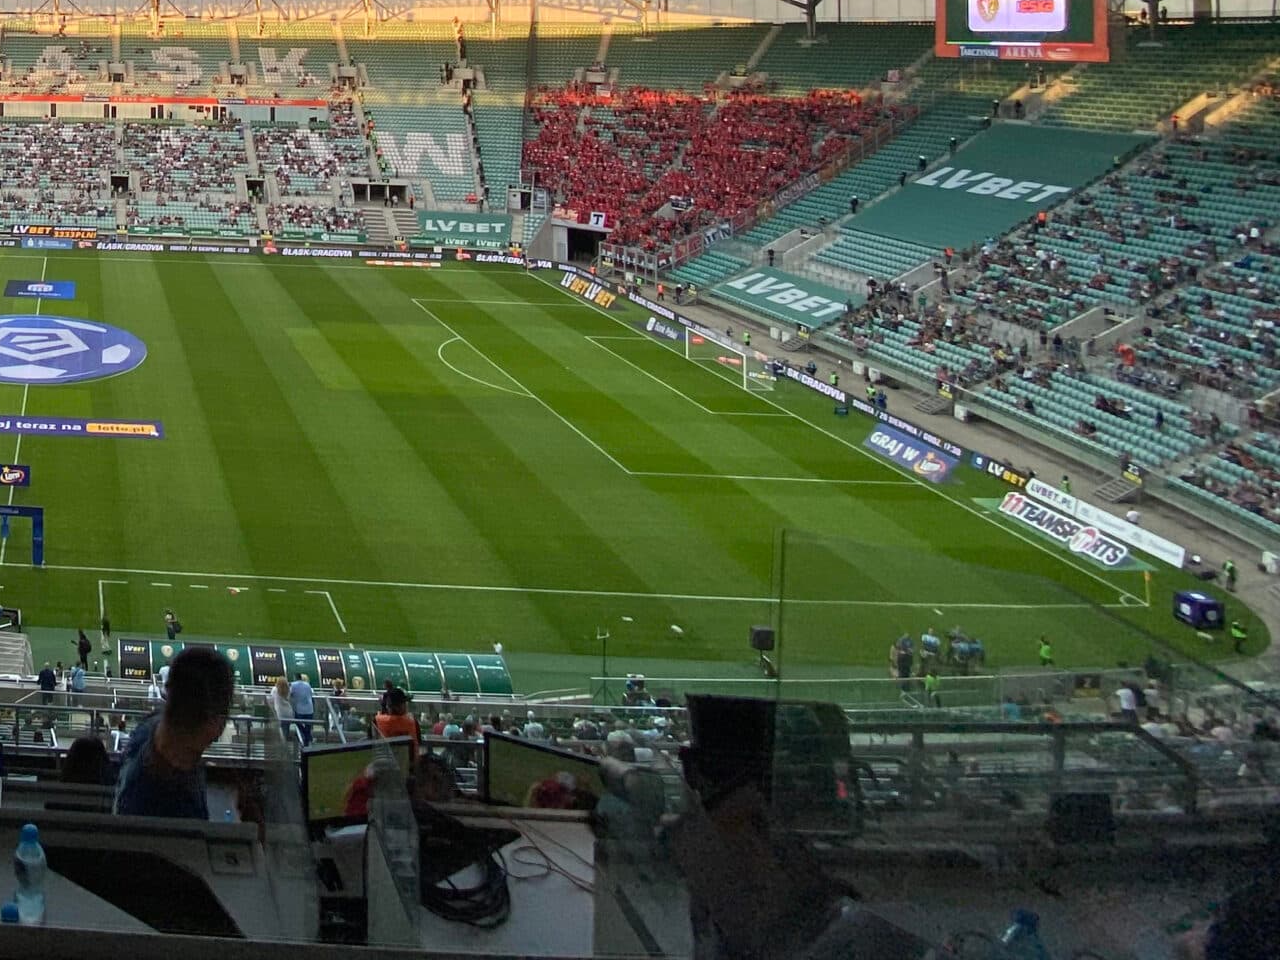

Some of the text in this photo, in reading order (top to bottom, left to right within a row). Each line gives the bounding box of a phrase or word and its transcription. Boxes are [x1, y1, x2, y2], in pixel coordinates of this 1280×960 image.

[1005, 47, 1042, 57] ARENA
[16, 421, 56, 430] teraz
[870, 431, 904, 456] GRAJ
[902, 446, 920, 462] W
[1030, 481, 1073, 510] LVBET.PL
